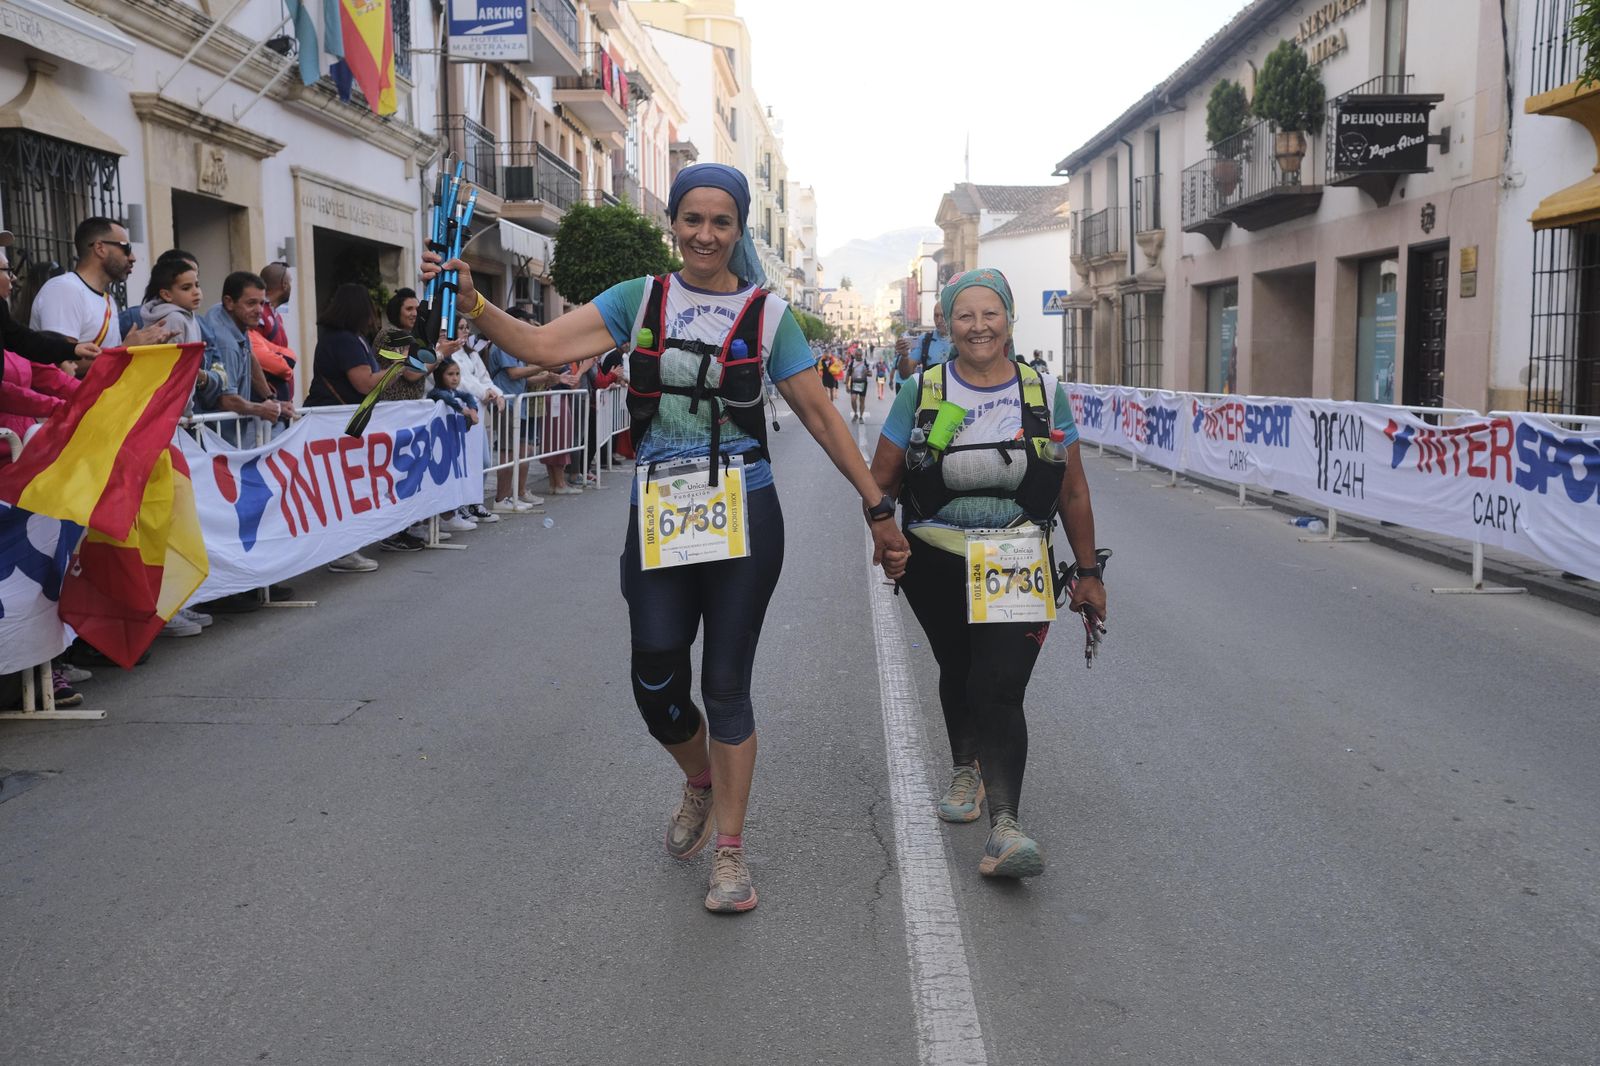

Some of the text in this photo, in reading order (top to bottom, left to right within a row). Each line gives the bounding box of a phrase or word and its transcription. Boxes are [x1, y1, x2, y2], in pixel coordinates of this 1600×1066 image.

[452, 43, 525, 51] MAESTRANZA
[1341, 112, 1426, 127] PELUQUERIA
[1368, 134, 1425, 159] Pepa Aires
[318, 196, 347, 219] HOTEL
[1070, 393, 1104, 430] TERSPORT
[1202, 403, 1294, 448] INTERSPORT
[1339, 414, 1364, 453] KM
[265, 413, 468, 538] INTERSPORT
[1413, 417, 1600, 504] INTERSPO
[1333, 459, 1365, 500] 24H
[659, 501, 727, 537] 6738
[1473, 492, 1521, 534] CARY
[985, 566, 1045, 595] 6736
